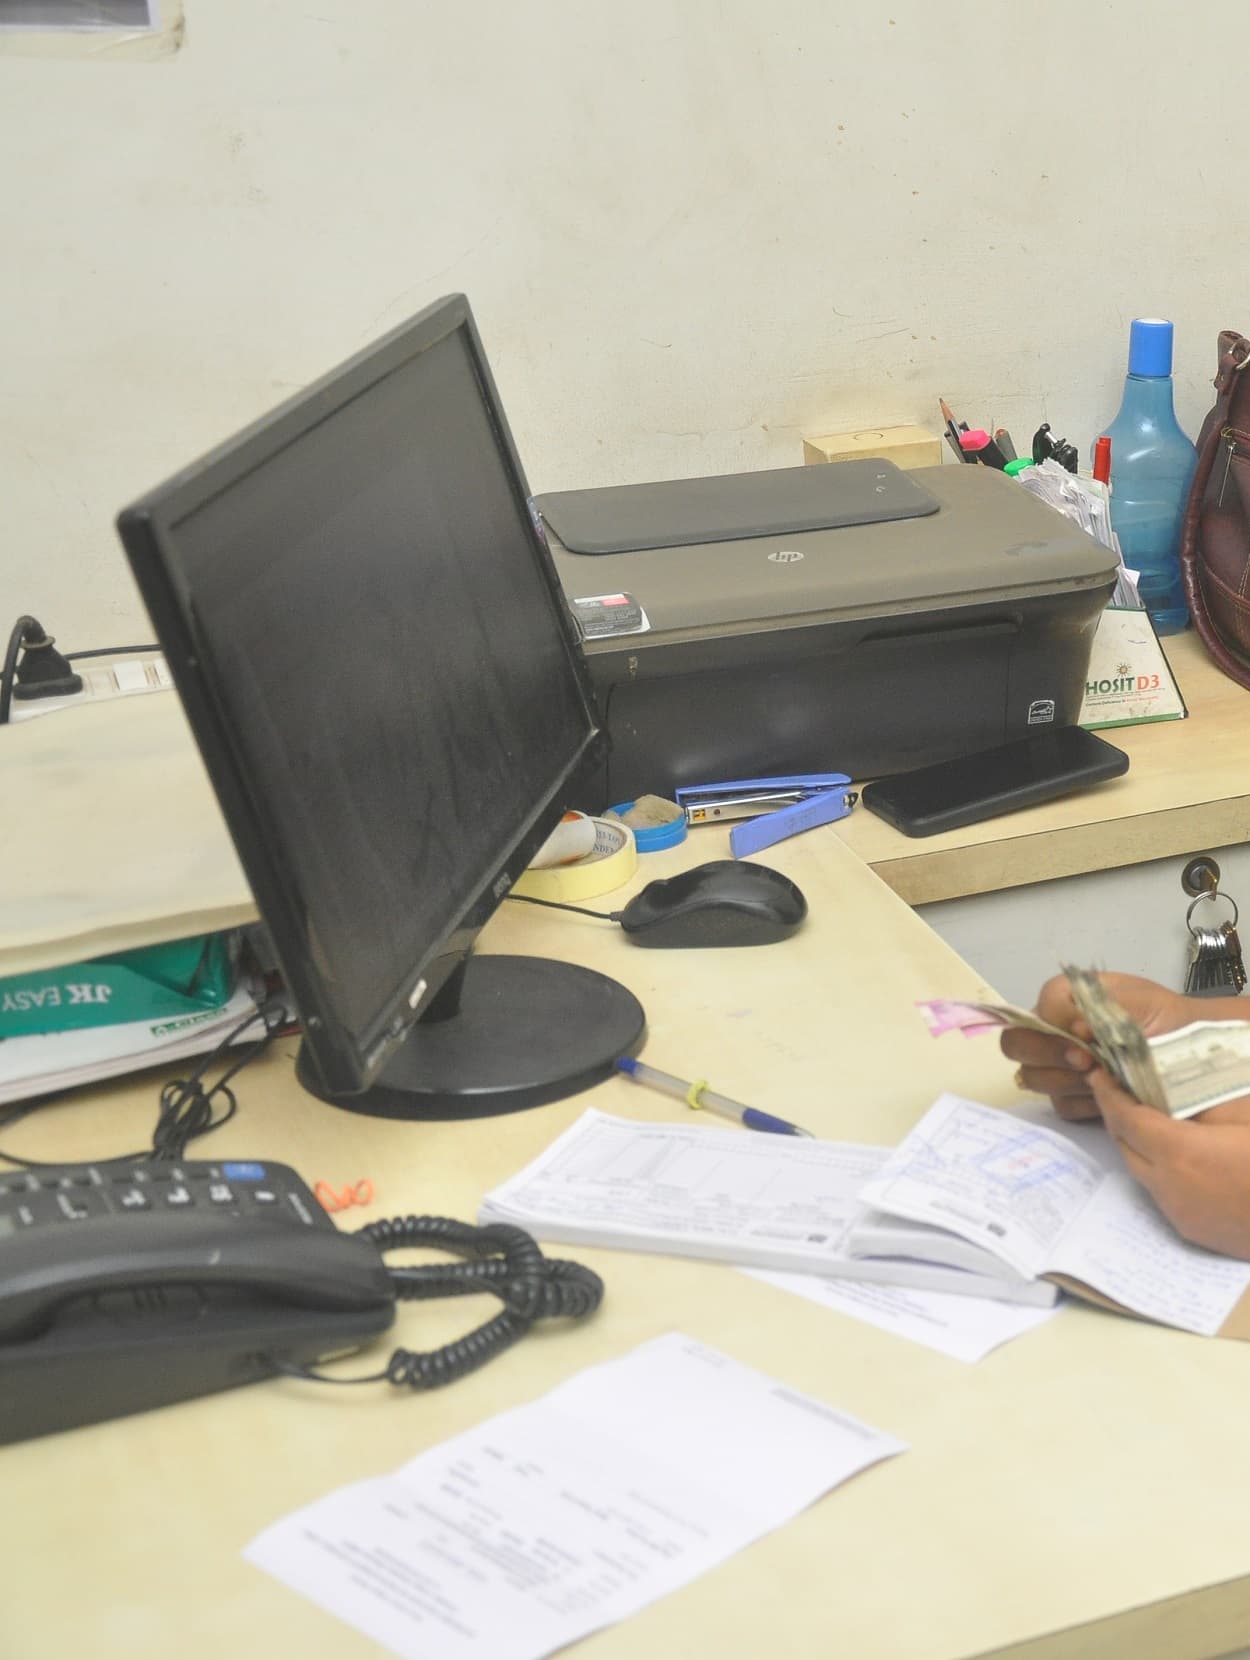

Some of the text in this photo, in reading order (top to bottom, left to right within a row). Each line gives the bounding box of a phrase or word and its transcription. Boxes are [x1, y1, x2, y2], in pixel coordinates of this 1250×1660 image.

[1085, 677, 1135, 695] HOSIT
[1137, 674, 1160, 690] D3
[2, 983, 112, 1011] JK EASY
